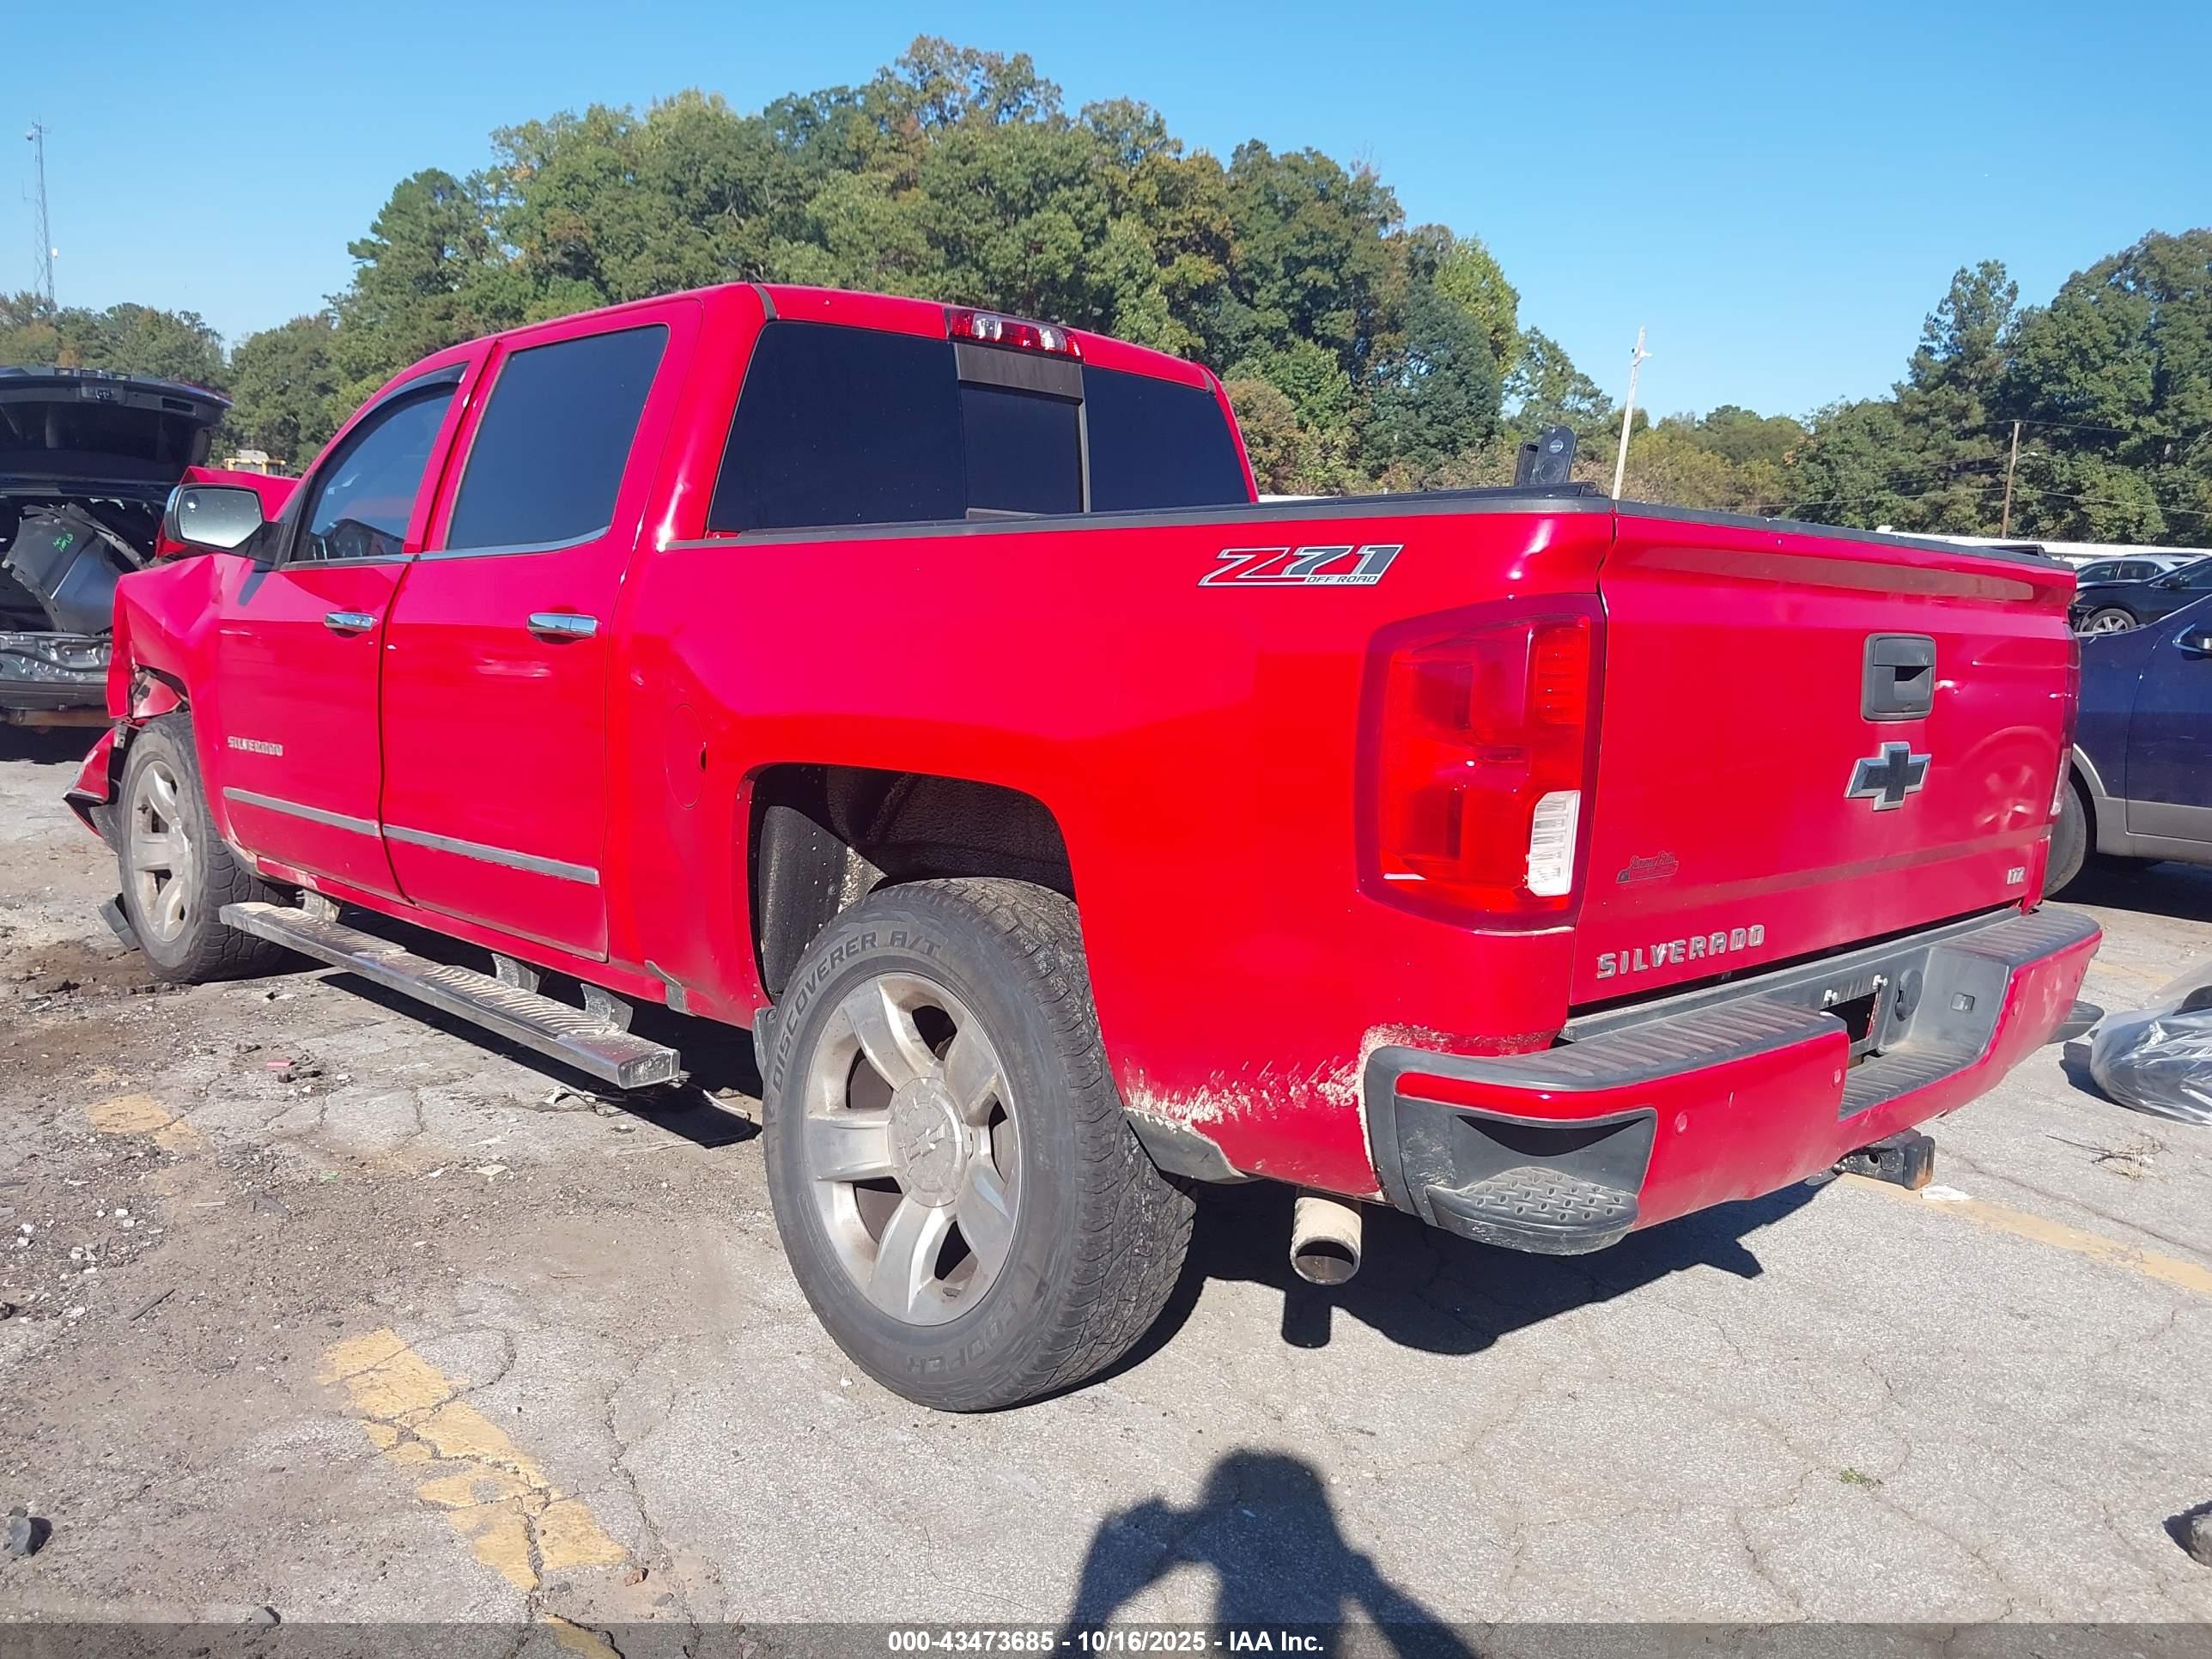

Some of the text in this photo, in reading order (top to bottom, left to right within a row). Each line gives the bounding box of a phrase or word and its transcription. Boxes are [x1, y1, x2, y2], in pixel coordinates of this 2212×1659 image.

[1197, 544, 1404, 586] Z71
[1306, 574, 1378, 584] OFF ROAD
[1595, 924, 1765, 979] SILVERADO
[773, 930, 942, 1093] DISCOVERER A/T
